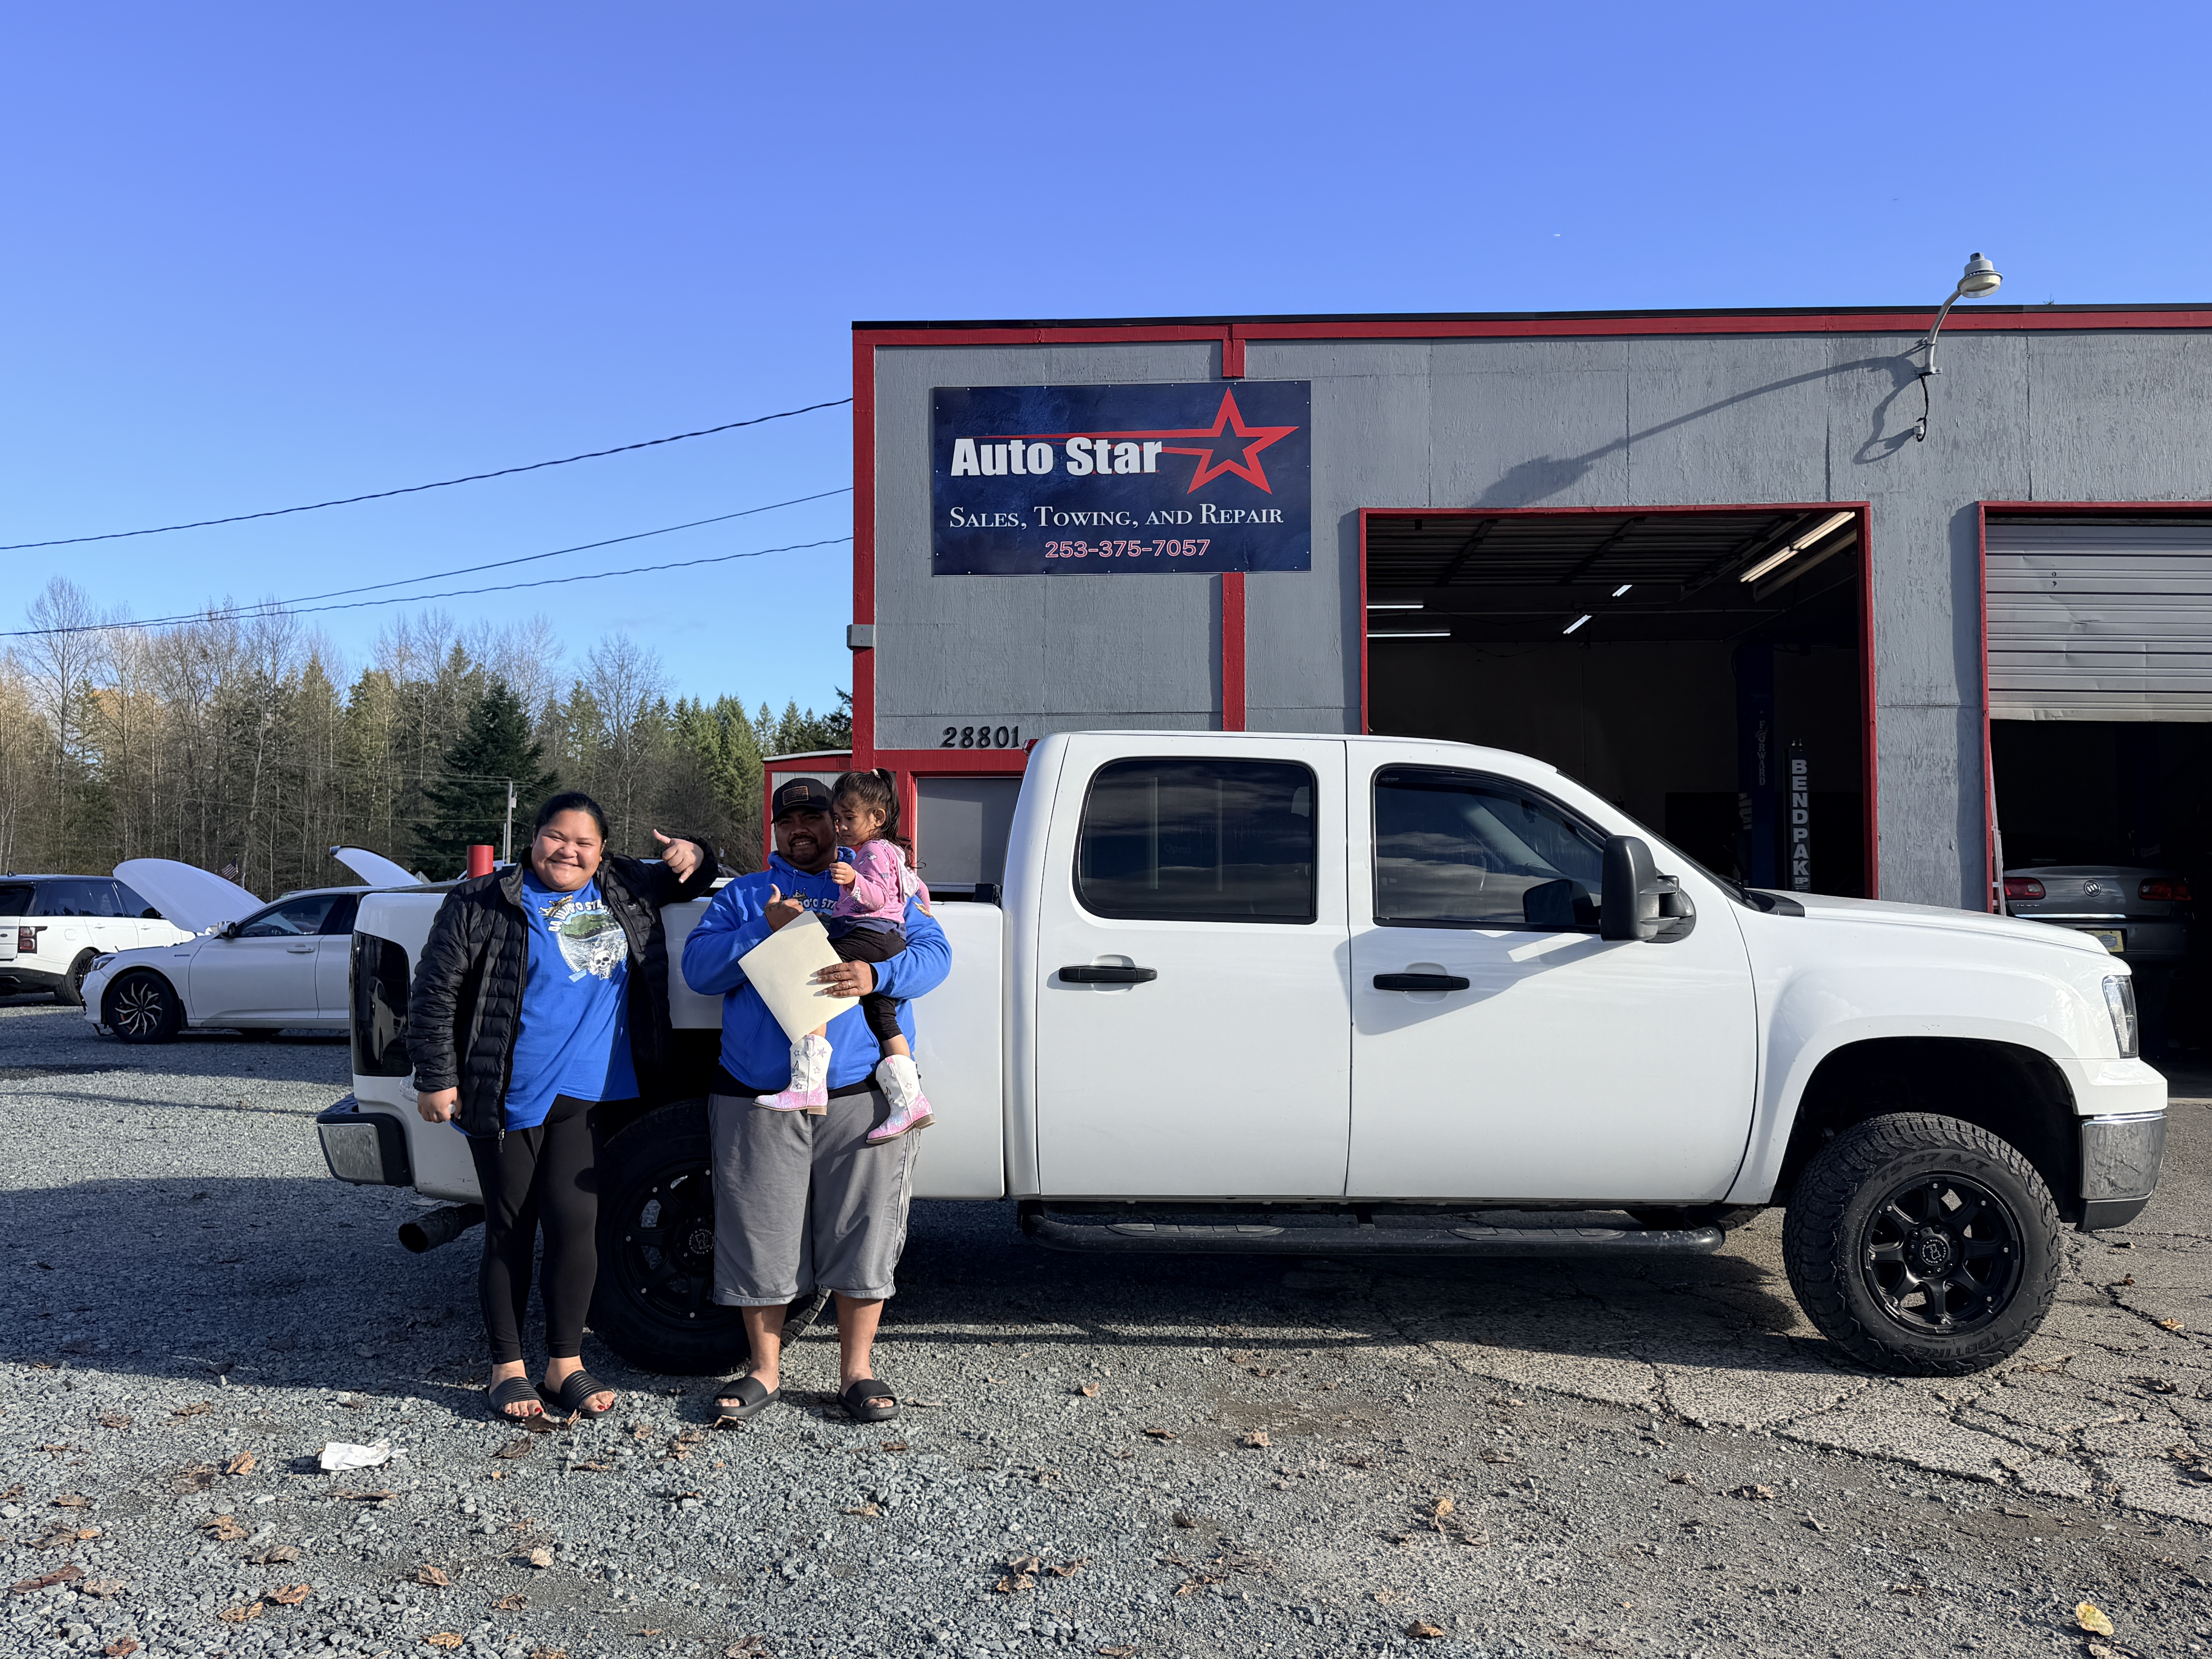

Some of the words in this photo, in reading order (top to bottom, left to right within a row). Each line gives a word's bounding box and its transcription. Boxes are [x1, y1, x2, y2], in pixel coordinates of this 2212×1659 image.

[950, 438, 1053, 476] Auto
[1066, 437, 1162, 475] Star
[1045, 539, 1210, 558] 253-375-7057
[940, 726, 1019, 748] 28801
[1757, 720, 1767, 786] FORWARD
[1791, 759, 1809, 876] BENDPAK
[1945, 1153, 1990, 1170] A/T
